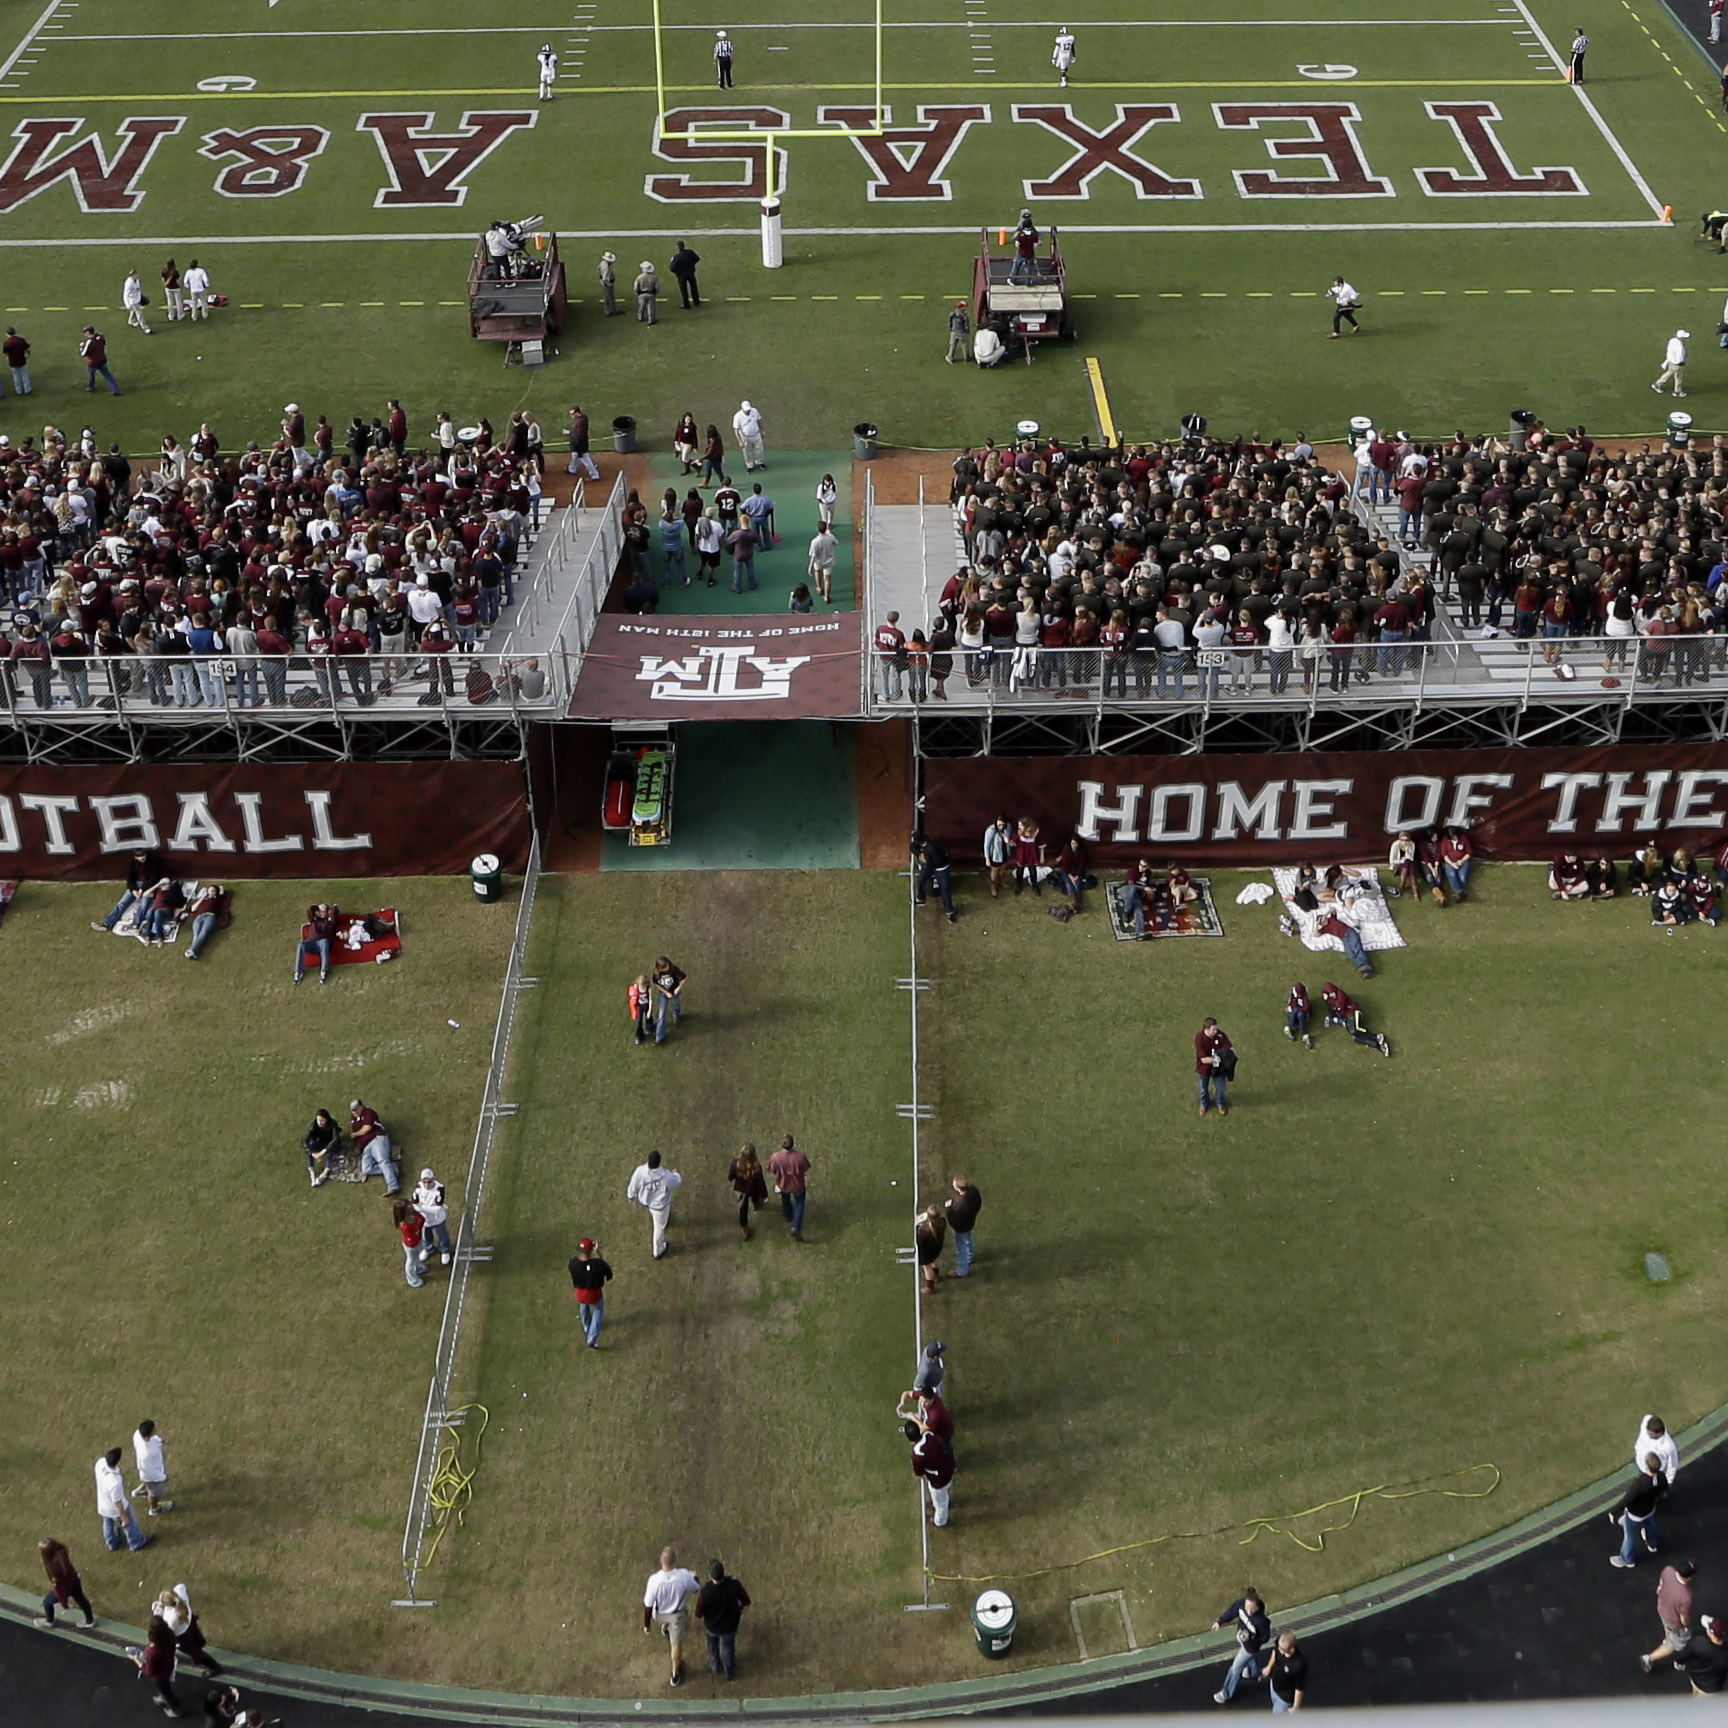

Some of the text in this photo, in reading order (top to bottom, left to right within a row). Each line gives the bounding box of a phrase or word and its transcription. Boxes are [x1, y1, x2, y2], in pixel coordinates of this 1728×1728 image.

[1296, 63, 1359, 80] G
[196, 75, 257, 92] G
[644, 101, 1591, 203] TEXAS
[721, 499, 734, 510] 12
[618, 624, 660, 635] MAN
[666, 629, 709, 637] 12TH
[759, 629, 783, 637] OF
[789, 623, 839, 634] HOME
[1075, 778, 1354, 842] HOME
[1384, 774, 1514, 834] OF
